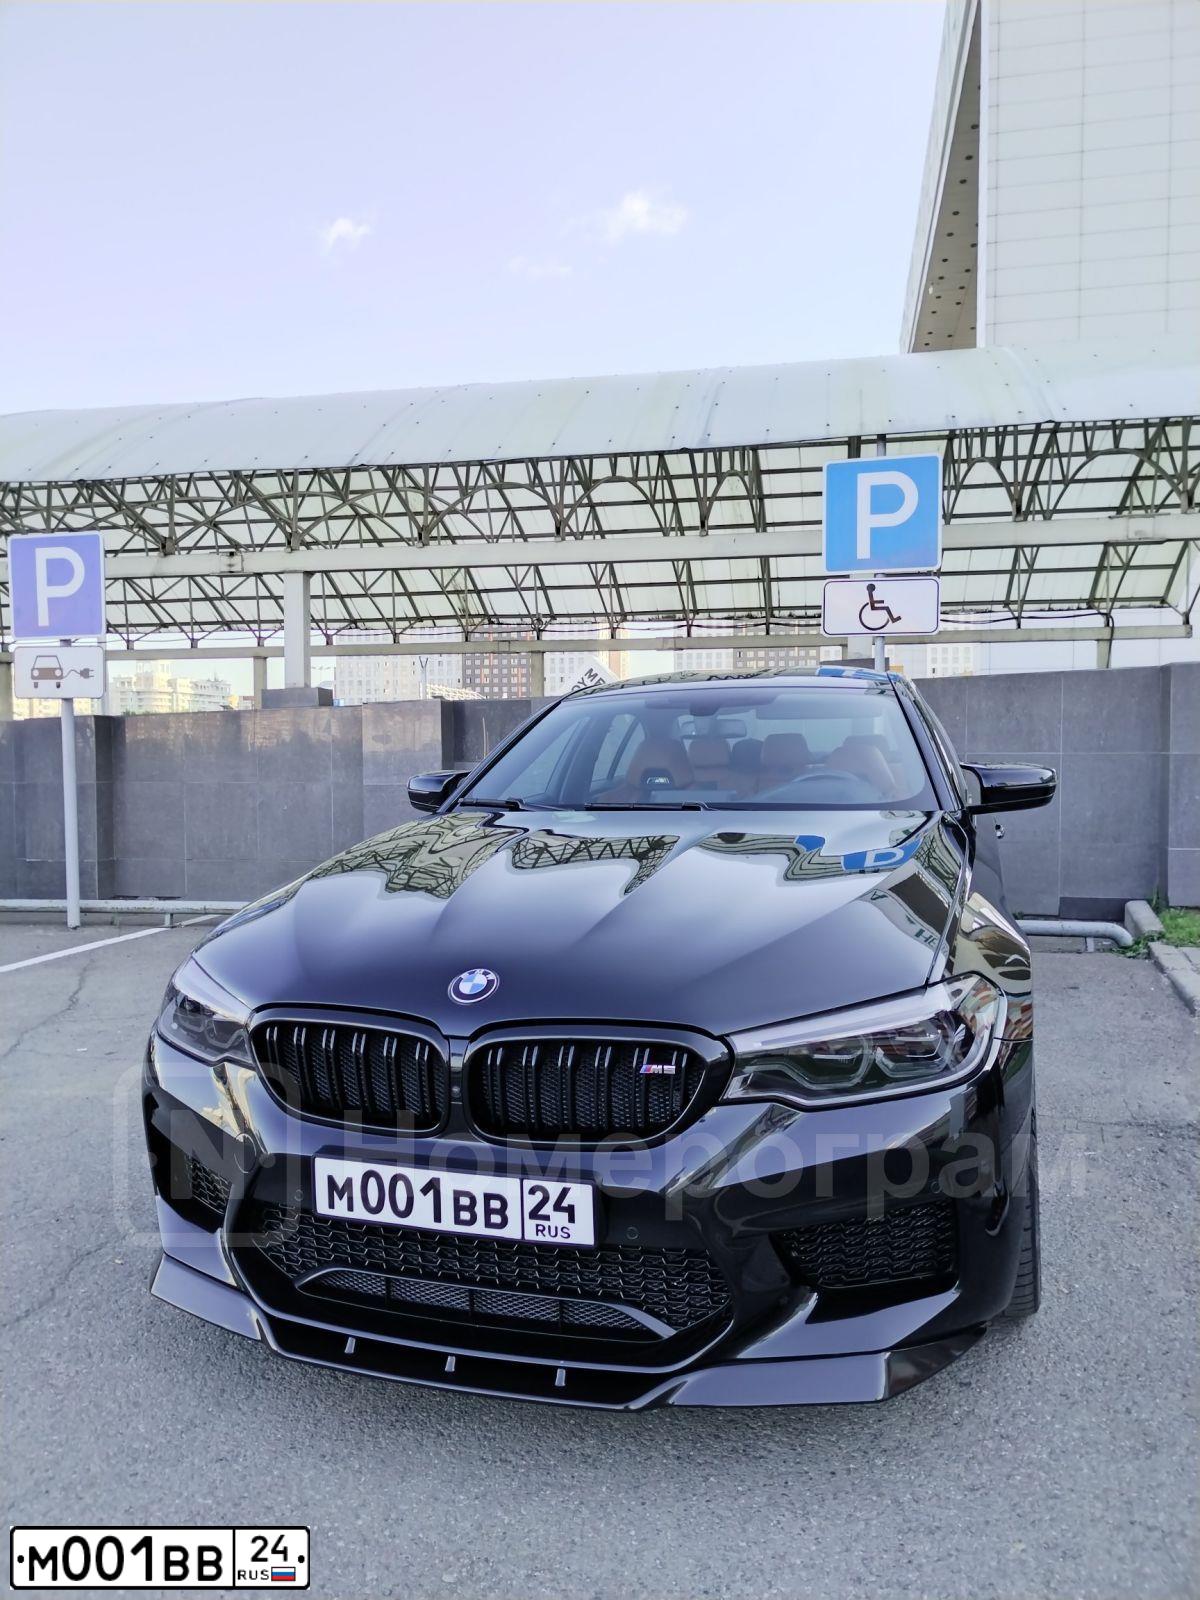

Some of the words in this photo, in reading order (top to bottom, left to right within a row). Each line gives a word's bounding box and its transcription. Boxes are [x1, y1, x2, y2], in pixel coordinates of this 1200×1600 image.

[857, 471, 919, 560] P
[35, 546, 85, 627] P
[527, 1184, 576, 1224] 24
[535, 1223, 571, 1239] RUS
